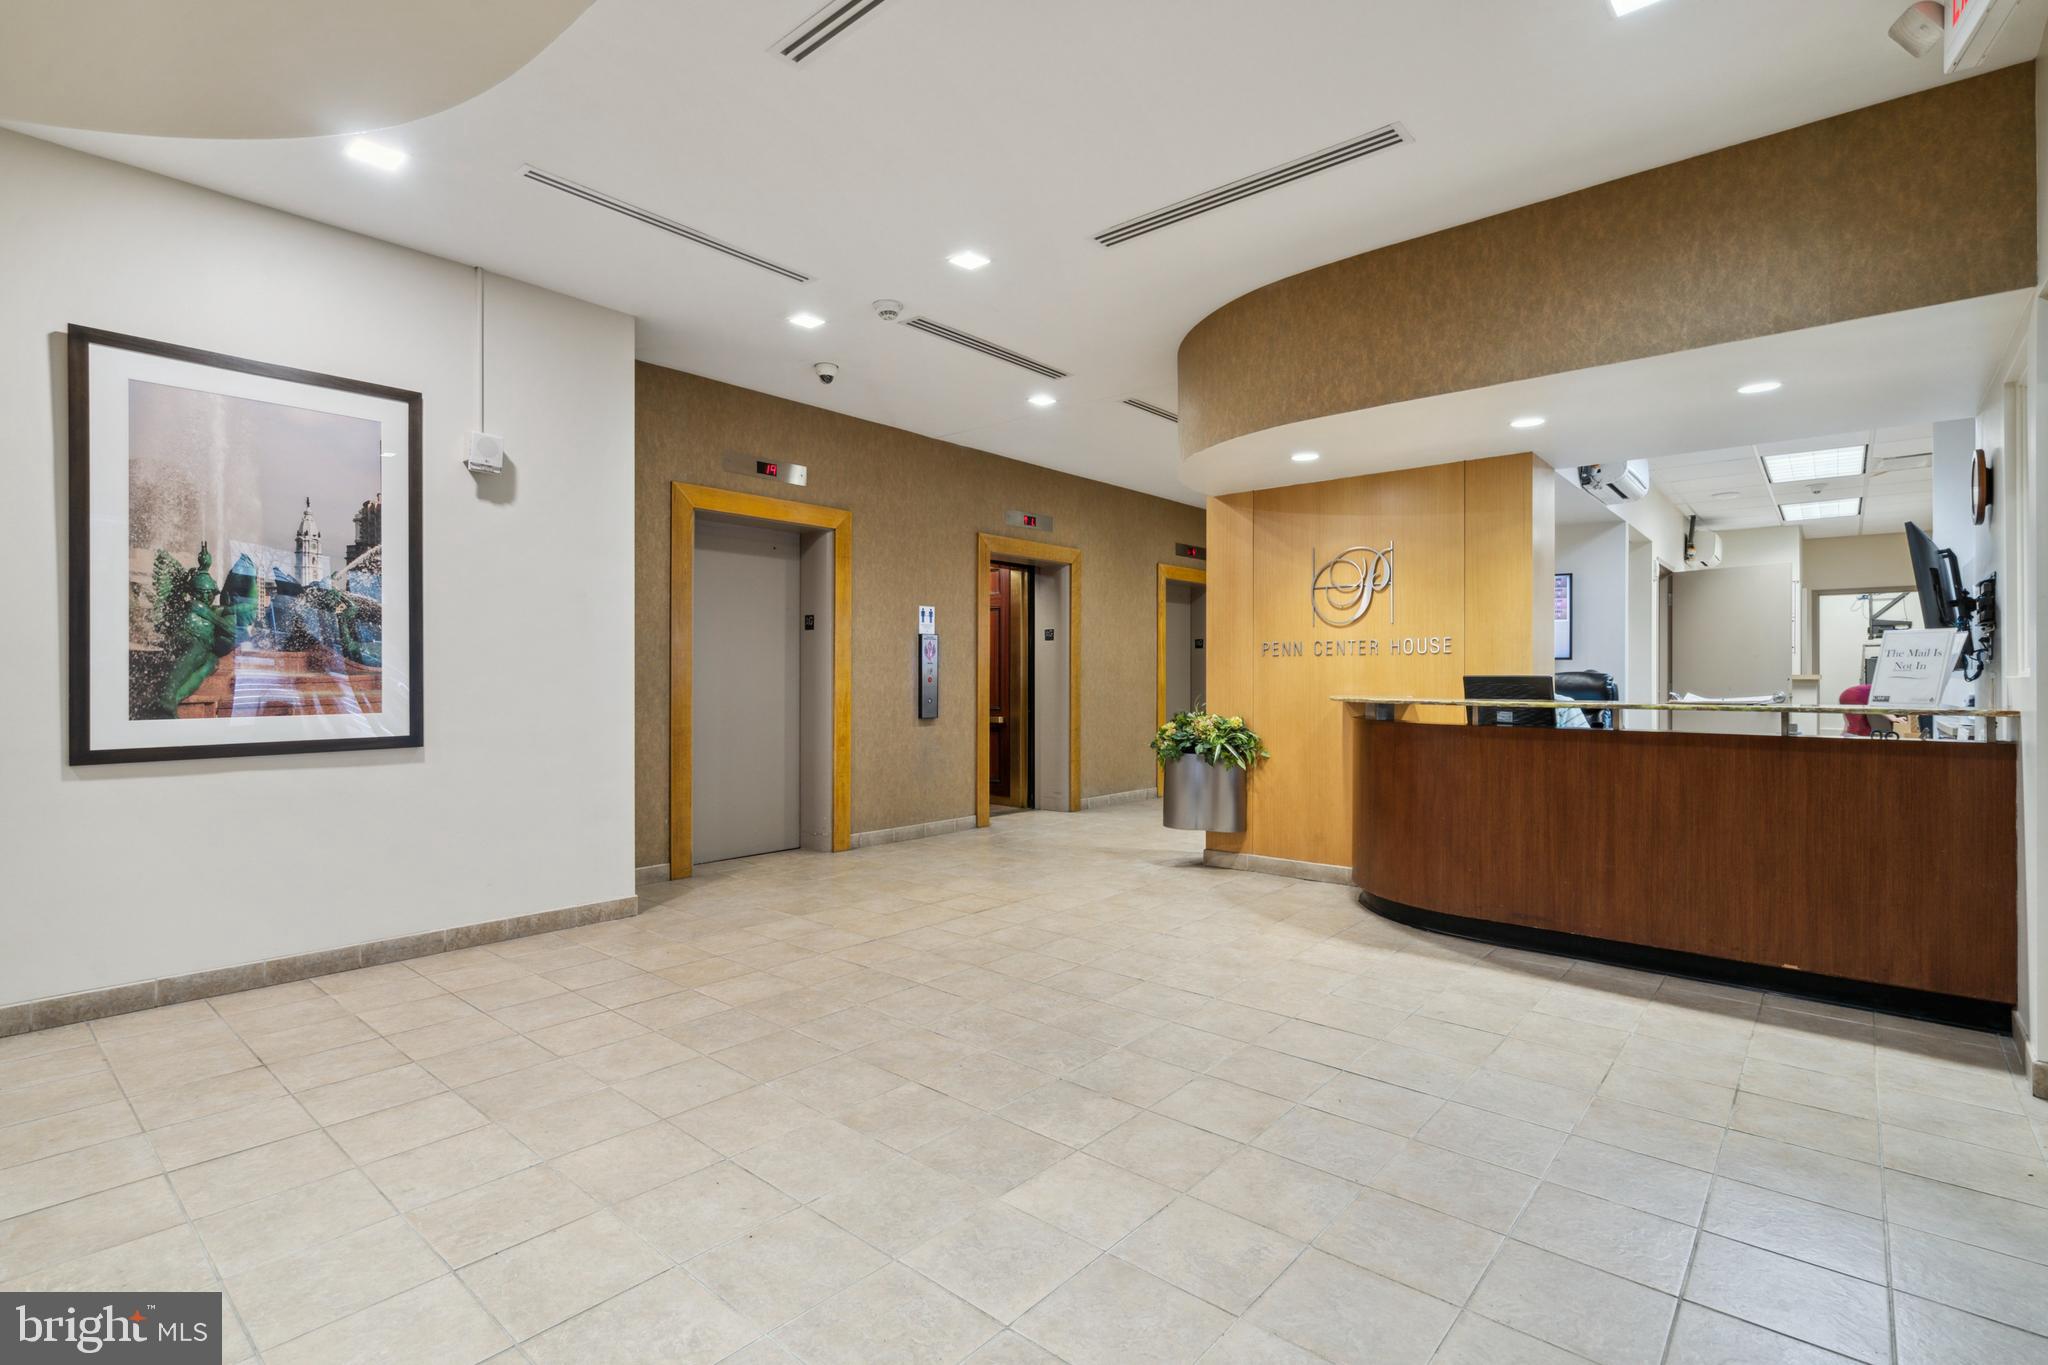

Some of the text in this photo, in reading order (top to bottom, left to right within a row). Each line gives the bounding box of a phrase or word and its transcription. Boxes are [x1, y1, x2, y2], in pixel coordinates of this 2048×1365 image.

[1262, 636, 1452, 657] PENN CENTER HOUSE
[1886, 648, 1942, 658] The Mail Is
[1895, 661, 1926, 671] Not In
